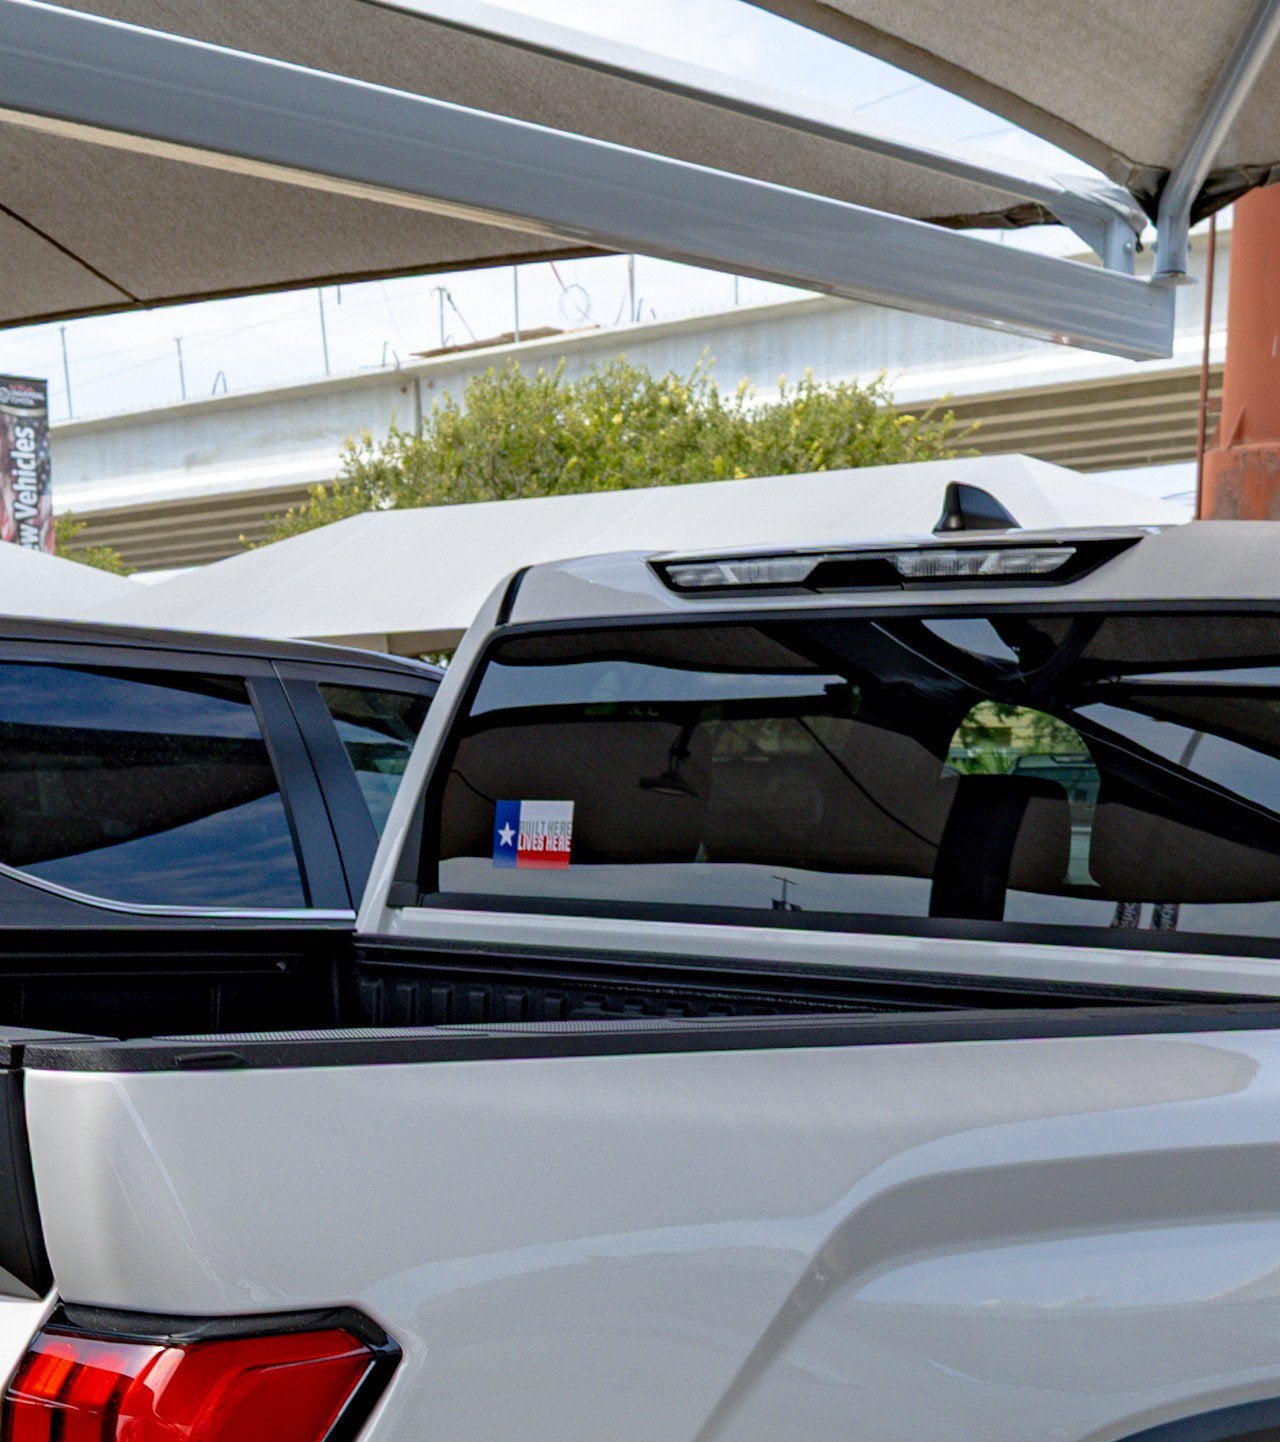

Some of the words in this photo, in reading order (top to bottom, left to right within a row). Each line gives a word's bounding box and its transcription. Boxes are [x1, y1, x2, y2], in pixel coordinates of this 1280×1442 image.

[10, 426, 39, 521] Vehicles
[520, 820, 546, 835] BUILT
[548, 821, 572, 836] HERE
[517, 834, 544, 851] LIVES
[546, 835, 571, 852] HERE
